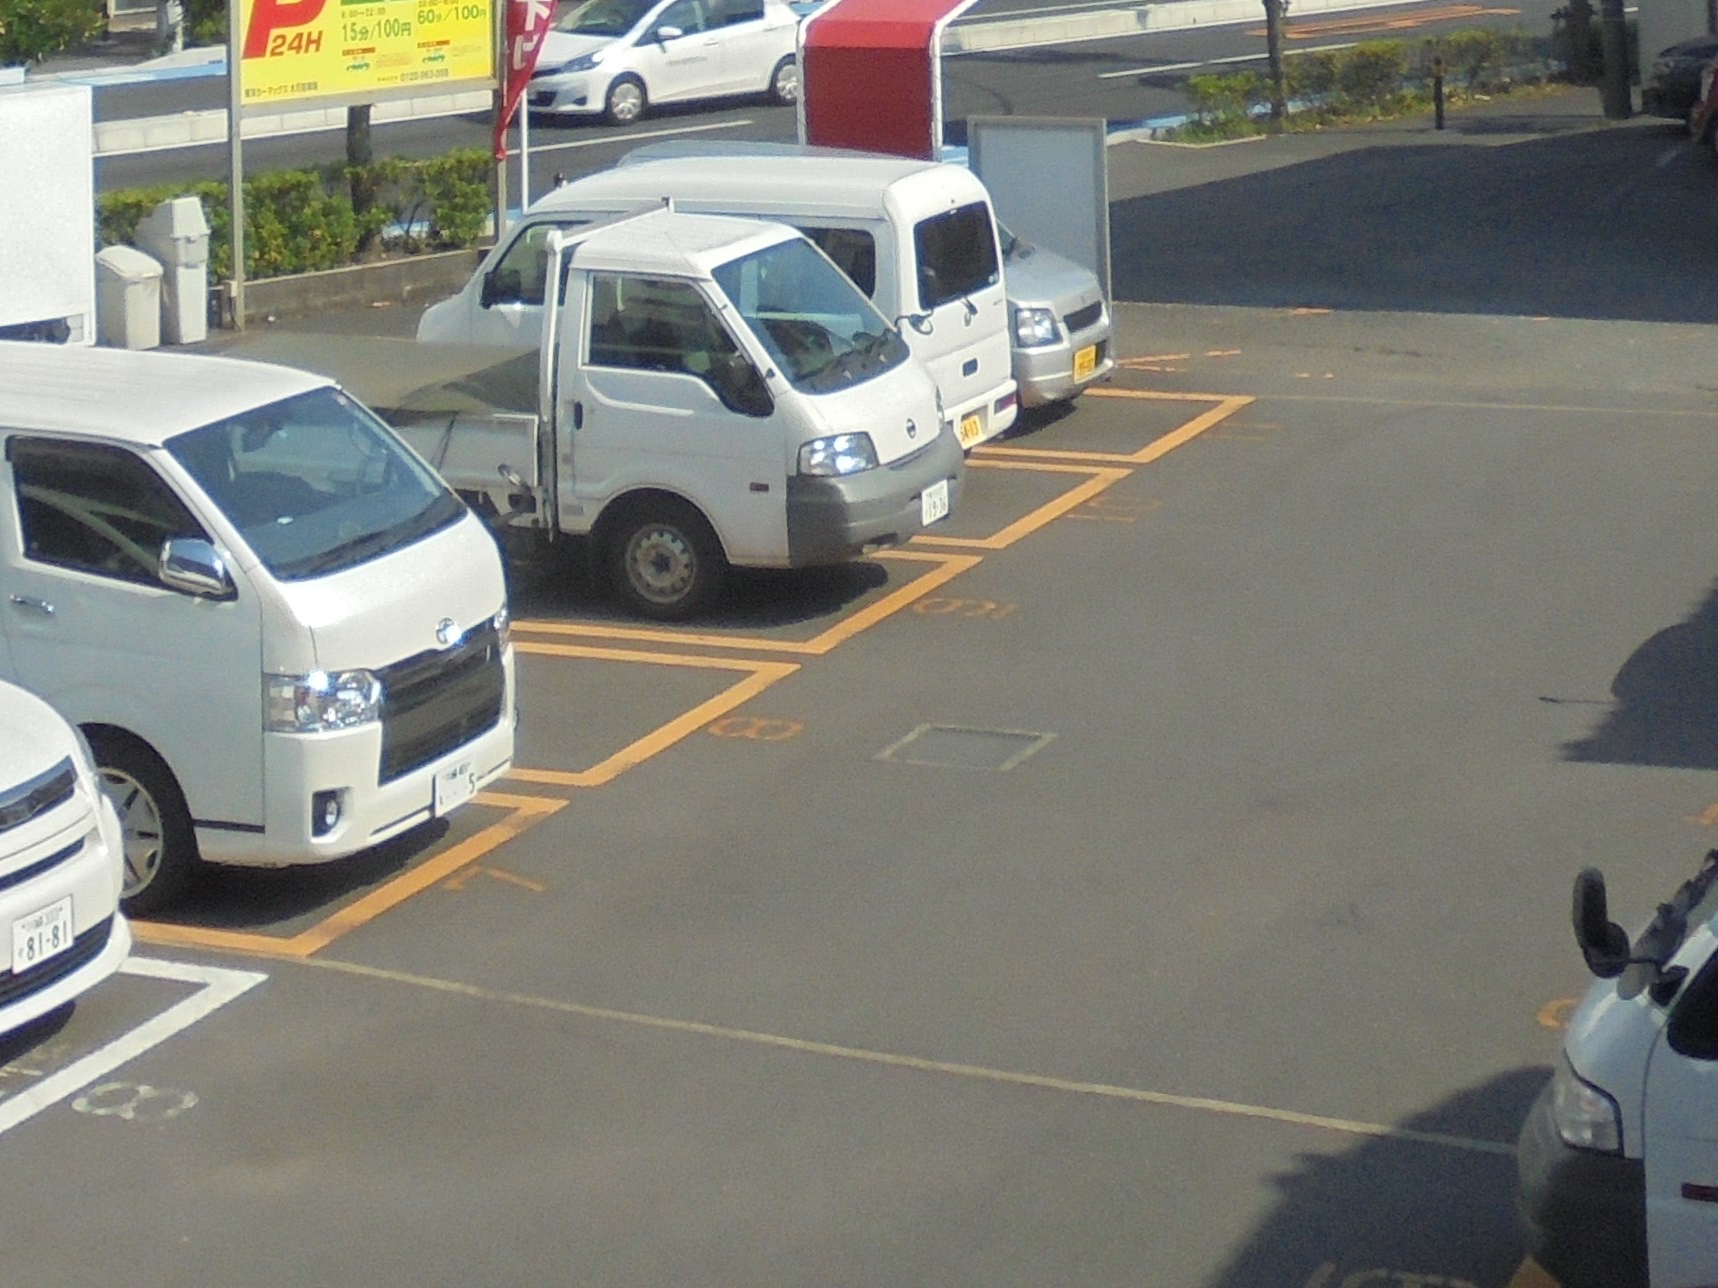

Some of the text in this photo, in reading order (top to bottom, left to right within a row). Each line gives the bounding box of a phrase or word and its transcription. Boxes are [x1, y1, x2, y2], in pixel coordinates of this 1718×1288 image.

[269, 30, 324, 57] 24H
[341, 18, 412, 42] 15分/100円
[26, 919, 68, 961] 81-81
